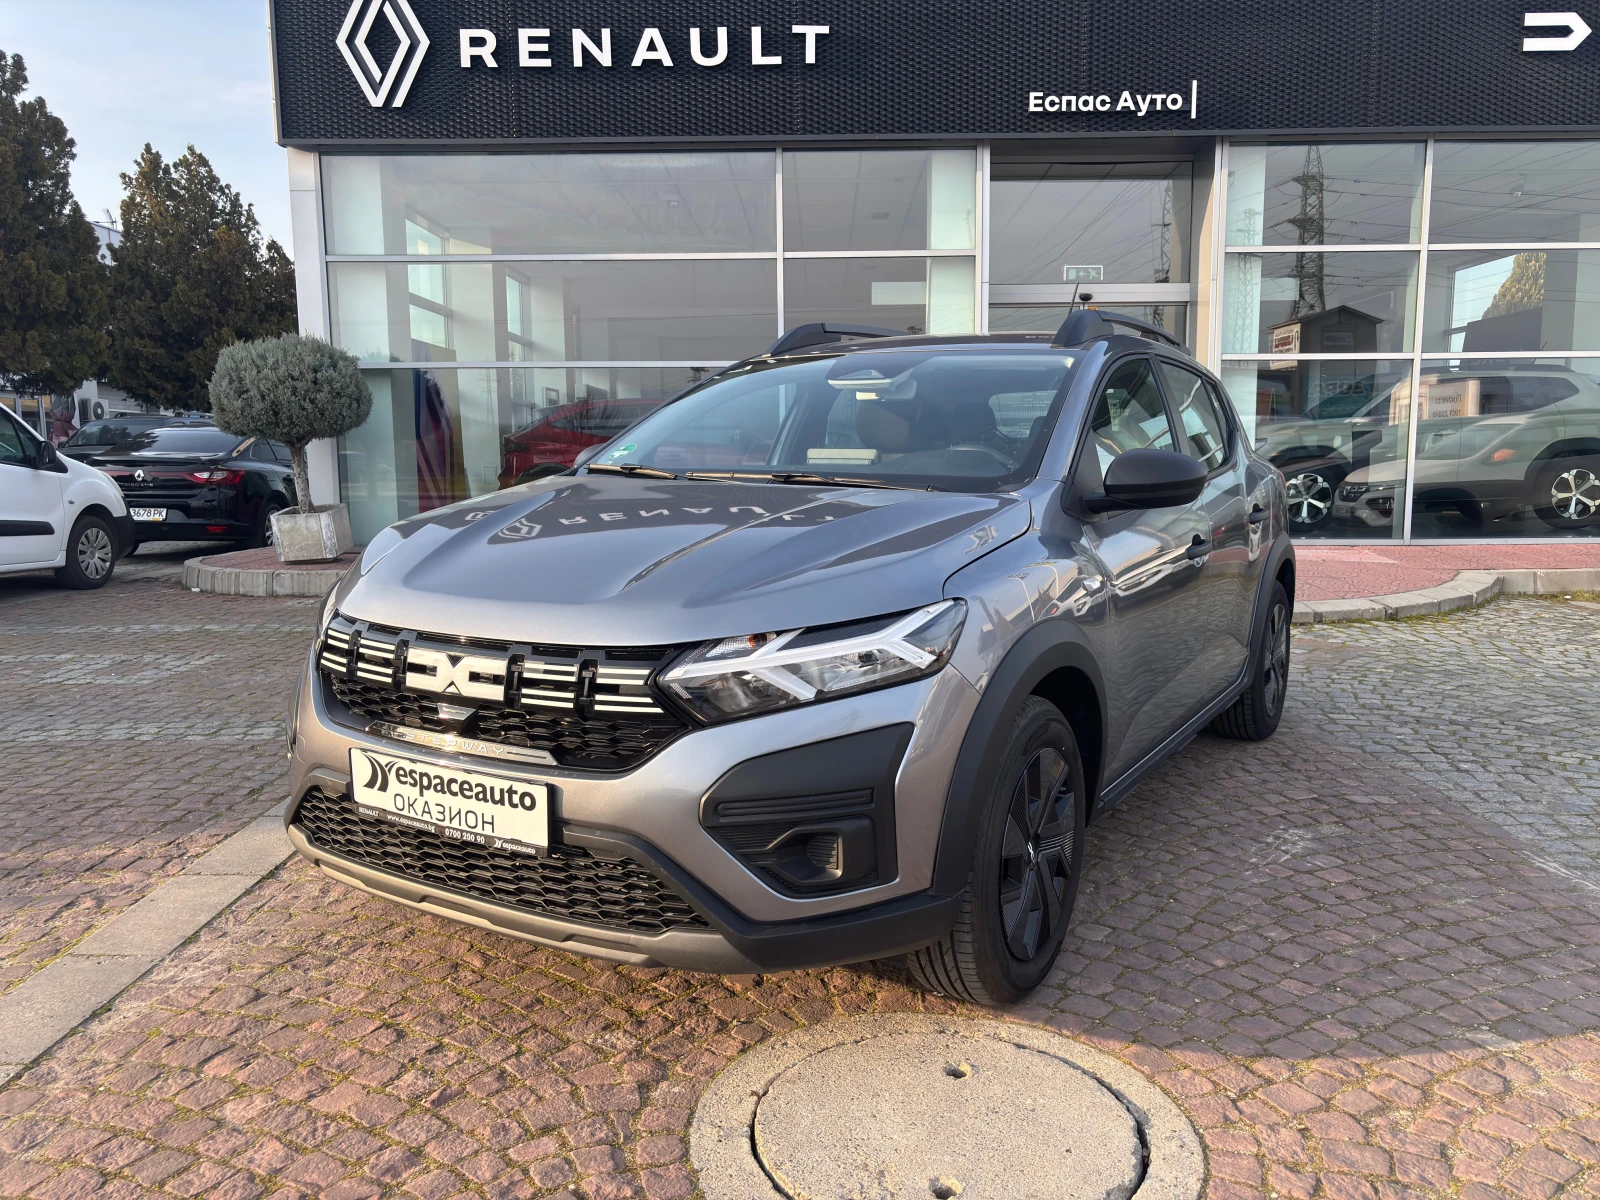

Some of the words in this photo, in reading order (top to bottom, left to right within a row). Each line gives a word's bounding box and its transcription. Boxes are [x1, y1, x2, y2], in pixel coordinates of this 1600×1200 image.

[459, 24, 830, 68] RENAULT
[1029, 92, 1111, 112] Еспас
[1116, 91, 1183, 117] Ауто
[404, 731, 504, 756] STEPWAY
[395, 766, 537, 811] espaceauto
[358, 806, 380, 817] RENAULT
[387, 814, 436, 833] www.espaceauto.bg
[445, 828, 461, 839] 0700
[462, 832, 475, 842] 200
[476, 835, 485, 844] 90
[502, 841, 536, 855] espaceauto
[394, 793, 495, 833] ОКАЗИОН
